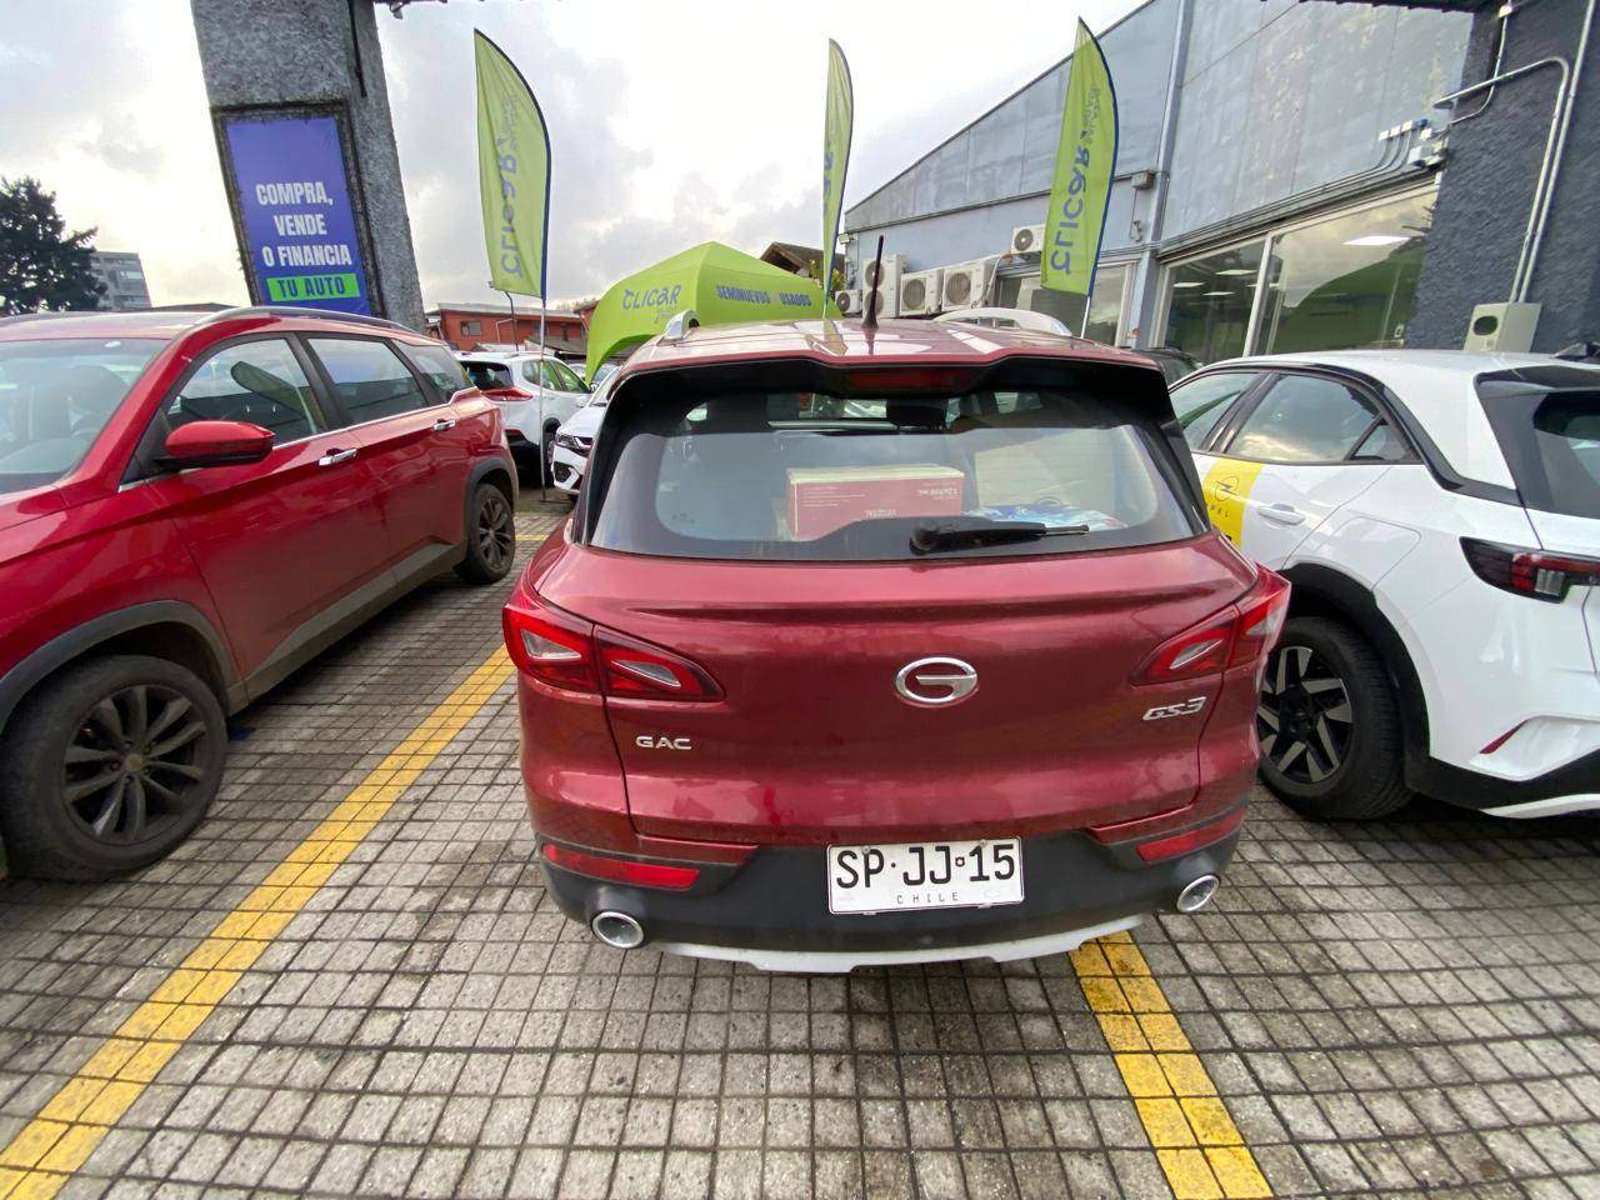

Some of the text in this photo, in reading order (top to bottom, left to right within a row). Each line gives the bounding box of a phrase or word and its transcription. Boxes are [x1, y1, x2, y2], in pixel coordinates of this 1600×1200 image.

[256, 181, 334, 206] COMPRA,
[274, 213, 328, 237] VENDE
[262, 244, 353, 268] O FINANCIA
[277, 276, 346, 298] TU AUTO
[1142, 695, 1207, 721] GS3
[635, 735, 692, 750] GAC
[896, 891, 960, 905] CHILE
